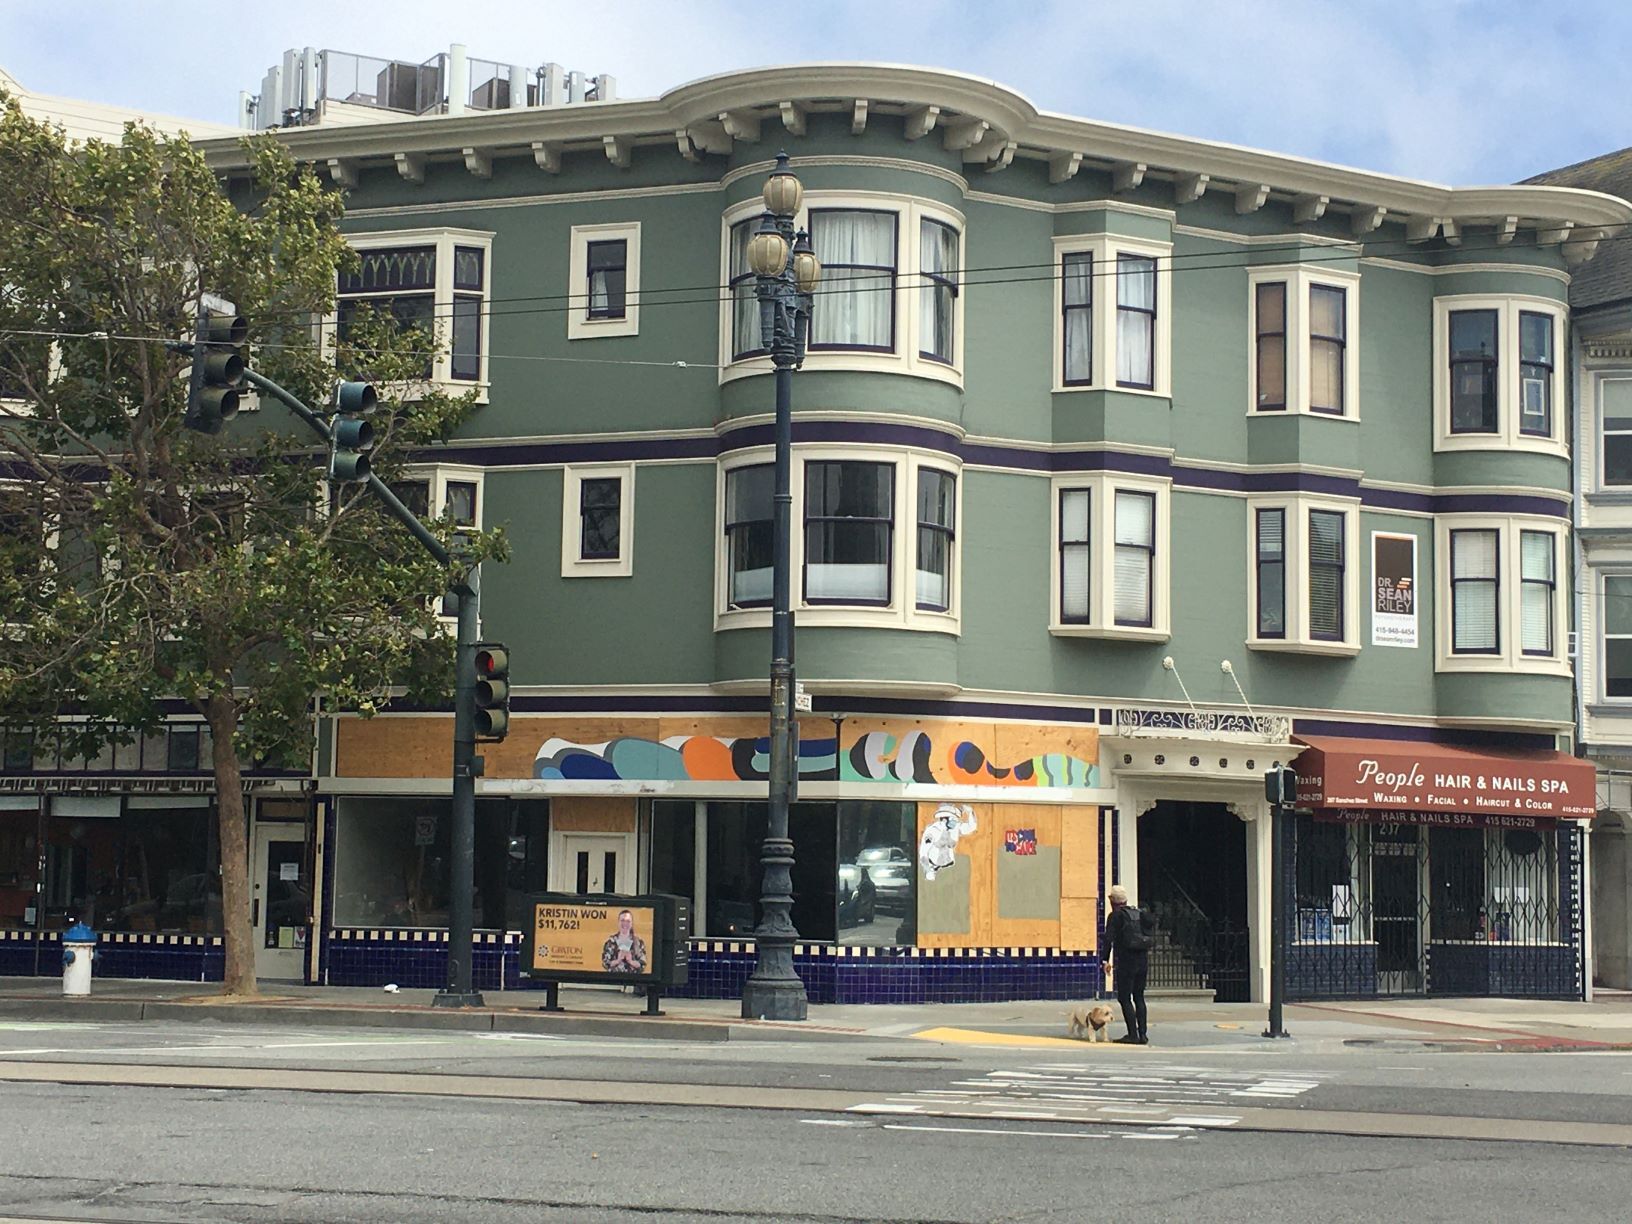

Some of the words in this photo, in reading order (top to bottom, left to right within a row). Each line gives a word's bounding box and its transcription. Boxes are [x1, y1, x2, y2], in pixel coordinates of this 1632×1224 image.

[1378, 577, 1394, 588] DR.
[1378, 588, 1412, 600] SEAN
[1378, 598, 1412, 612] RILEY
[1356, 759, 1425, 792] People
[1434, 774, 1472, 789] HAIR
[1477, 776, 1487, 789] &
[1492, 777, 1535, 792] NAILS
[1541, 779, 1569, 793] SPA
[1514, 799, 1522, 808] &
[1337, 808, 1370, 822] People
[1381, 812, 1406, 821] HAIR
[1410, 812, 1417, 821] &
[1420, 814, 1450, 823] NAILS
[1454, 815, 1473, 825] SPA
[1485, 816, 1499, 825] 415
[538, 908, 578, 919] KRISTIN
[581, 910, 607, 920] WON
[538, 919, 580, 930] $11,762!
